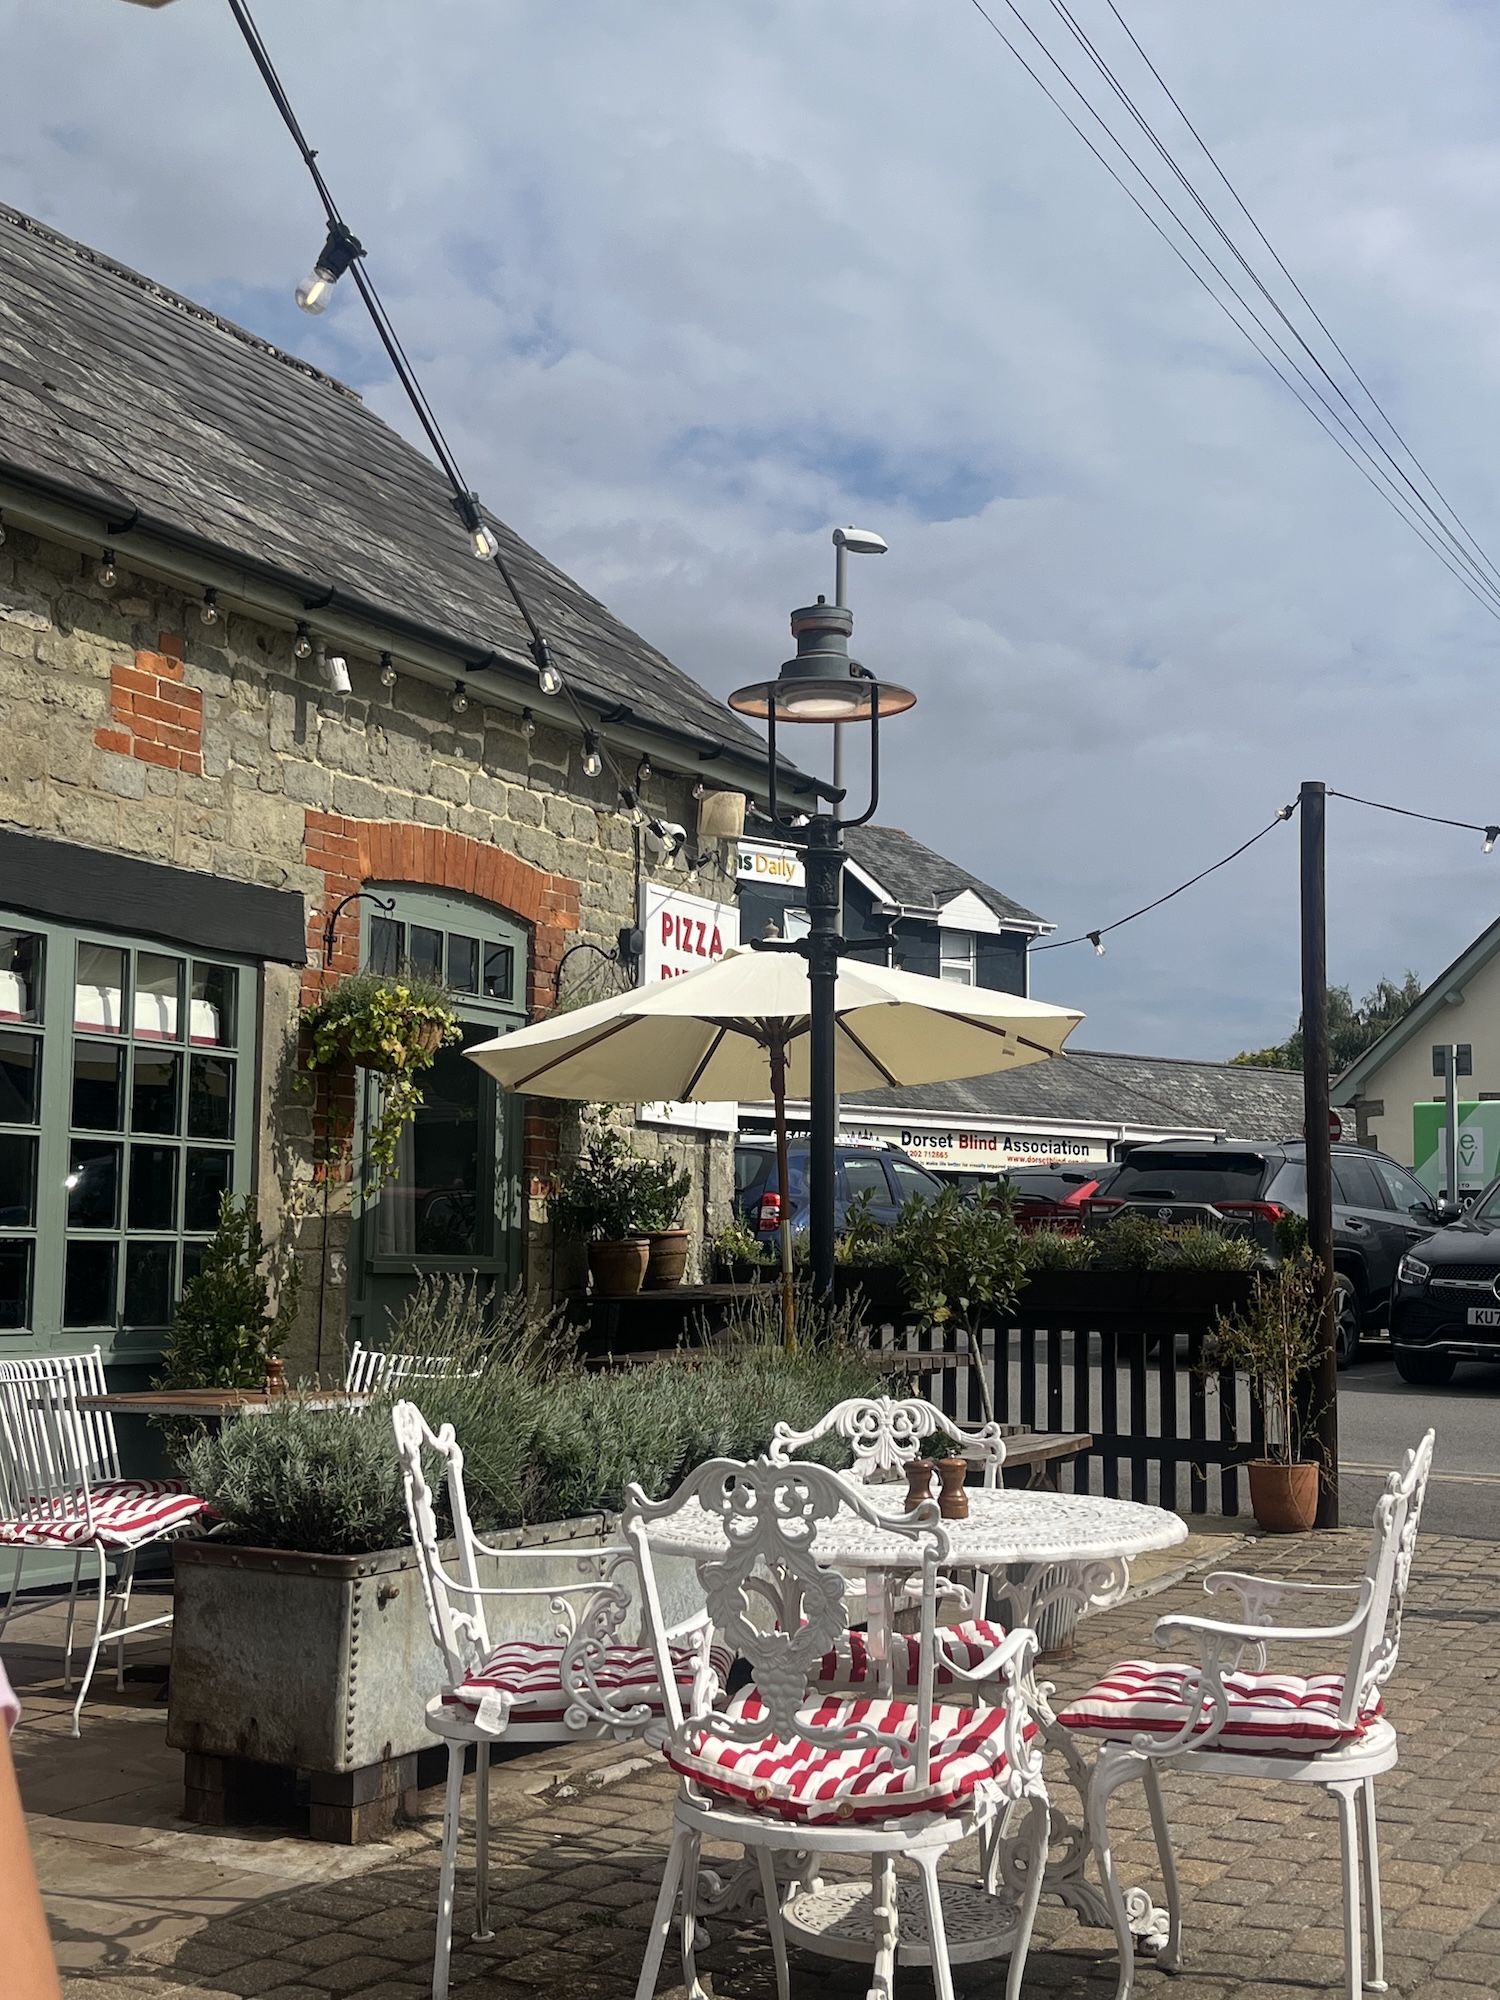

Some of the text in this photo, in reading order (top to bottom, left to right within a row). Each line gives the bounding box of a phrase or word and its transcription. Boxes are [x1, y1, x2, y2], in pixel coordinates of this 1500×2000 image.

[756, 853, 796, 882] Daily
[662, 911, 723, 958] PIZZA
[901, 1131, 1089, 1156] Dorset Blind Association
